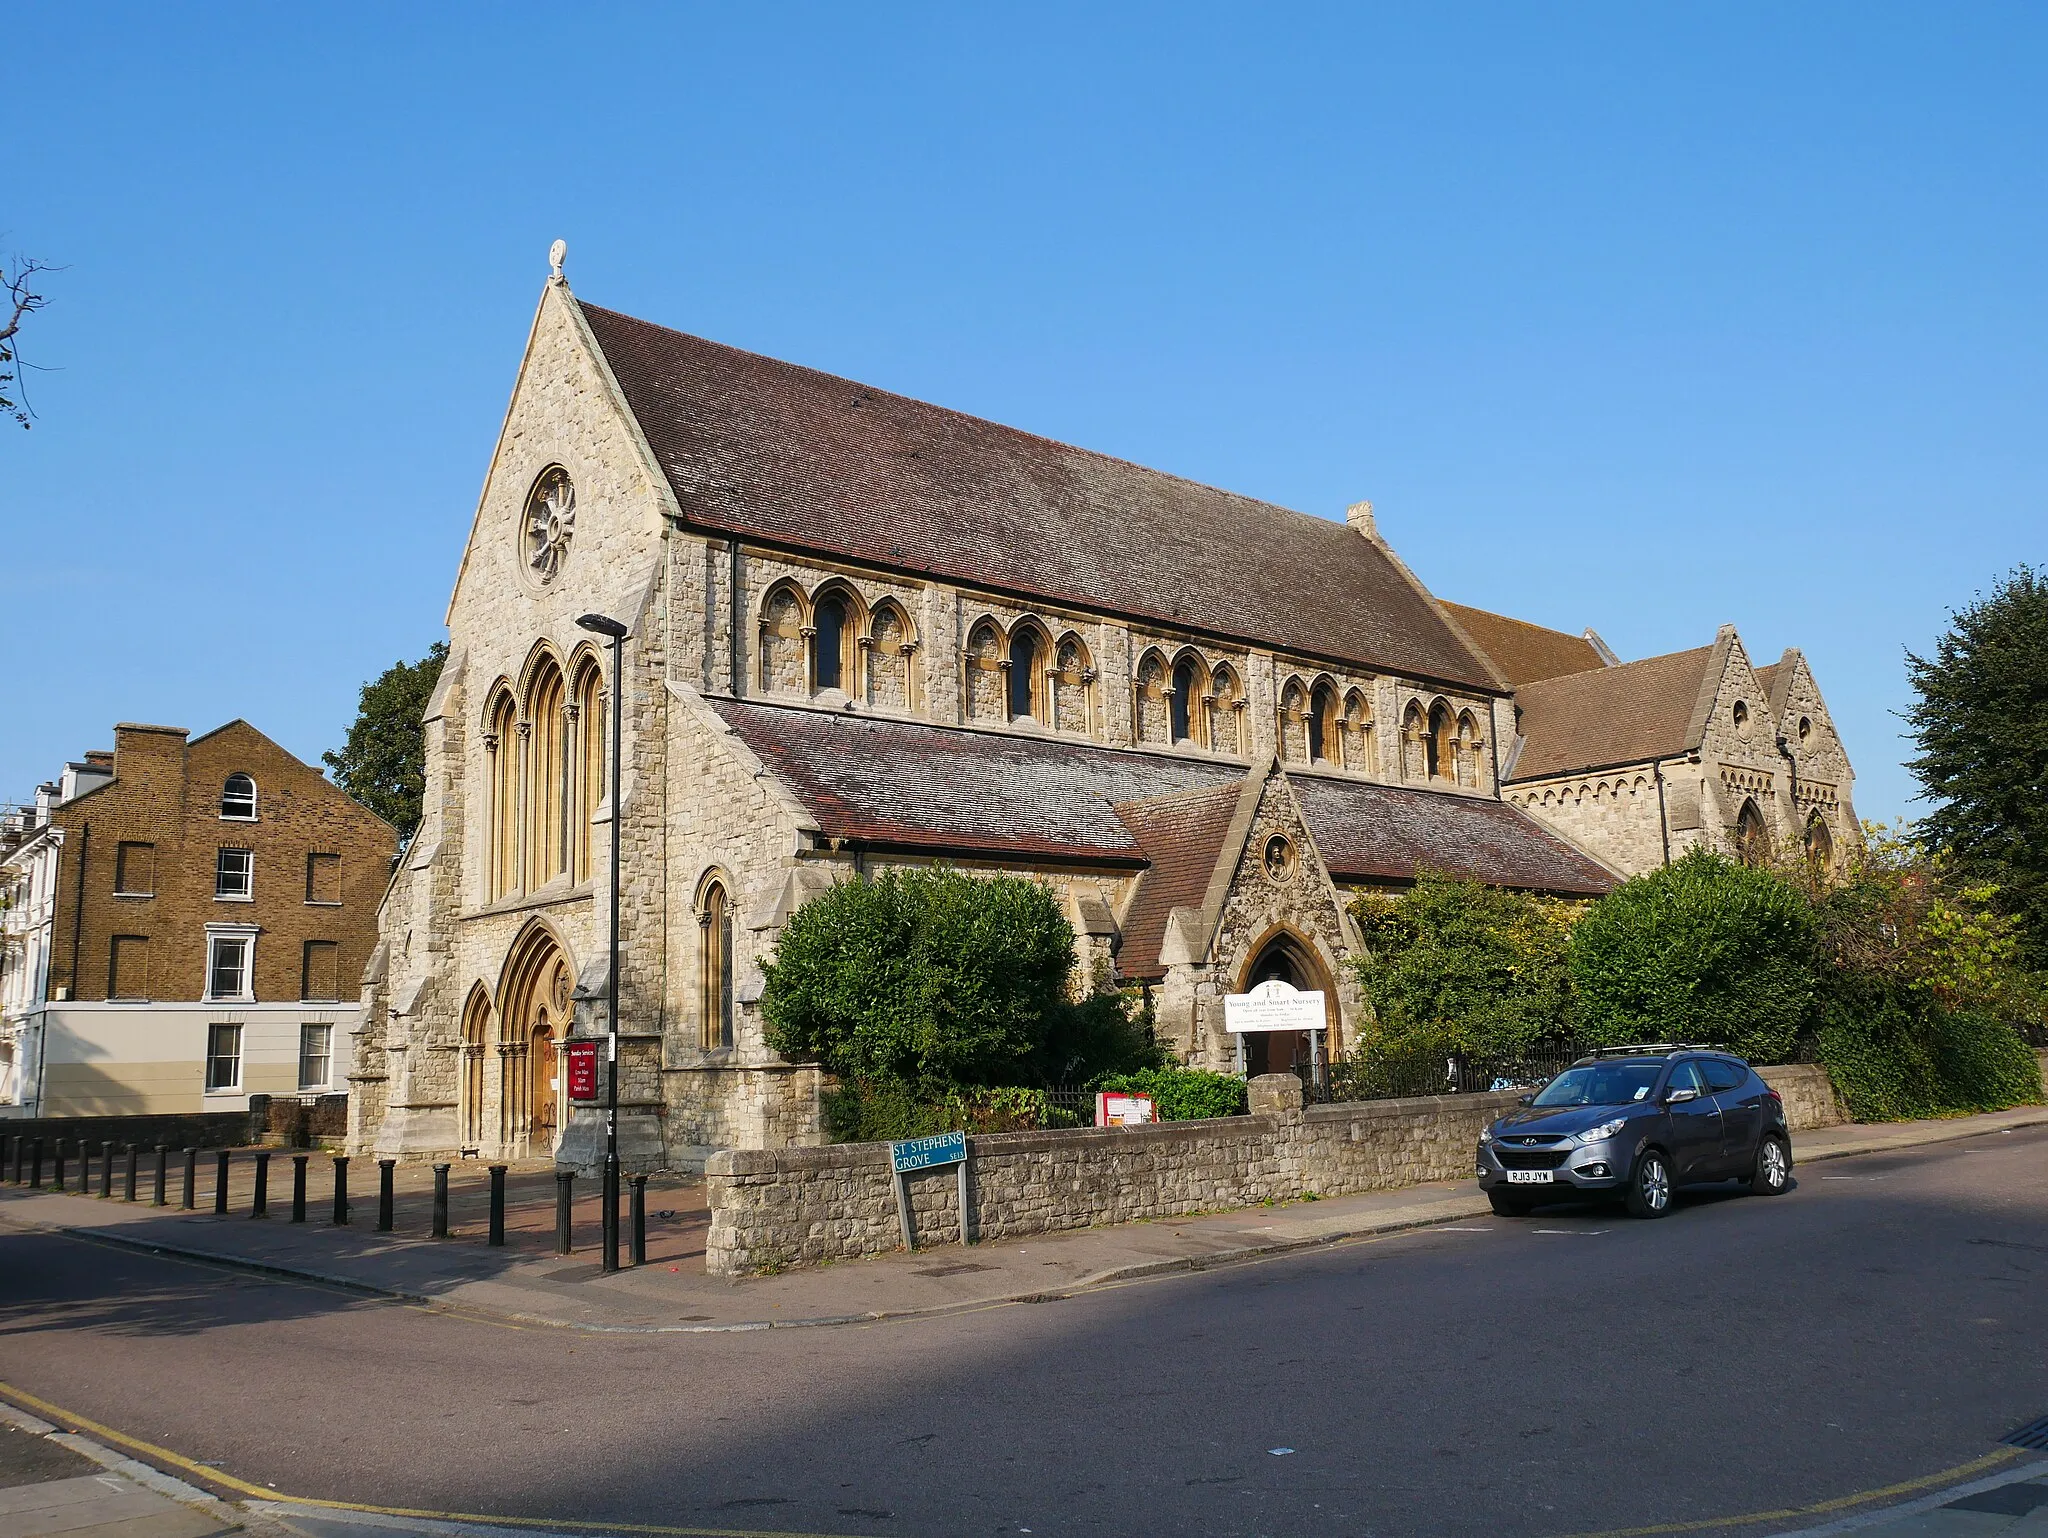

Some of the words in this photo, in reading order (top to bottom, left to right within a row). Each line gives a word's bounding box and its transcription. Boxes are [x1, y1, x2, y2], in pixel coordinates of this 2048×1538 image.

[1292, 998, 1320, 1006] Nursery
[911, 1133, 962, 1152] STEPHENS
[896, 1153, 930, 1170] GROVE
[950, 1152, 964, 1160] SE13
[1512, 1172, 1530, 1180] RJ13
[1533, 1172, 1548, 1180] JYW
